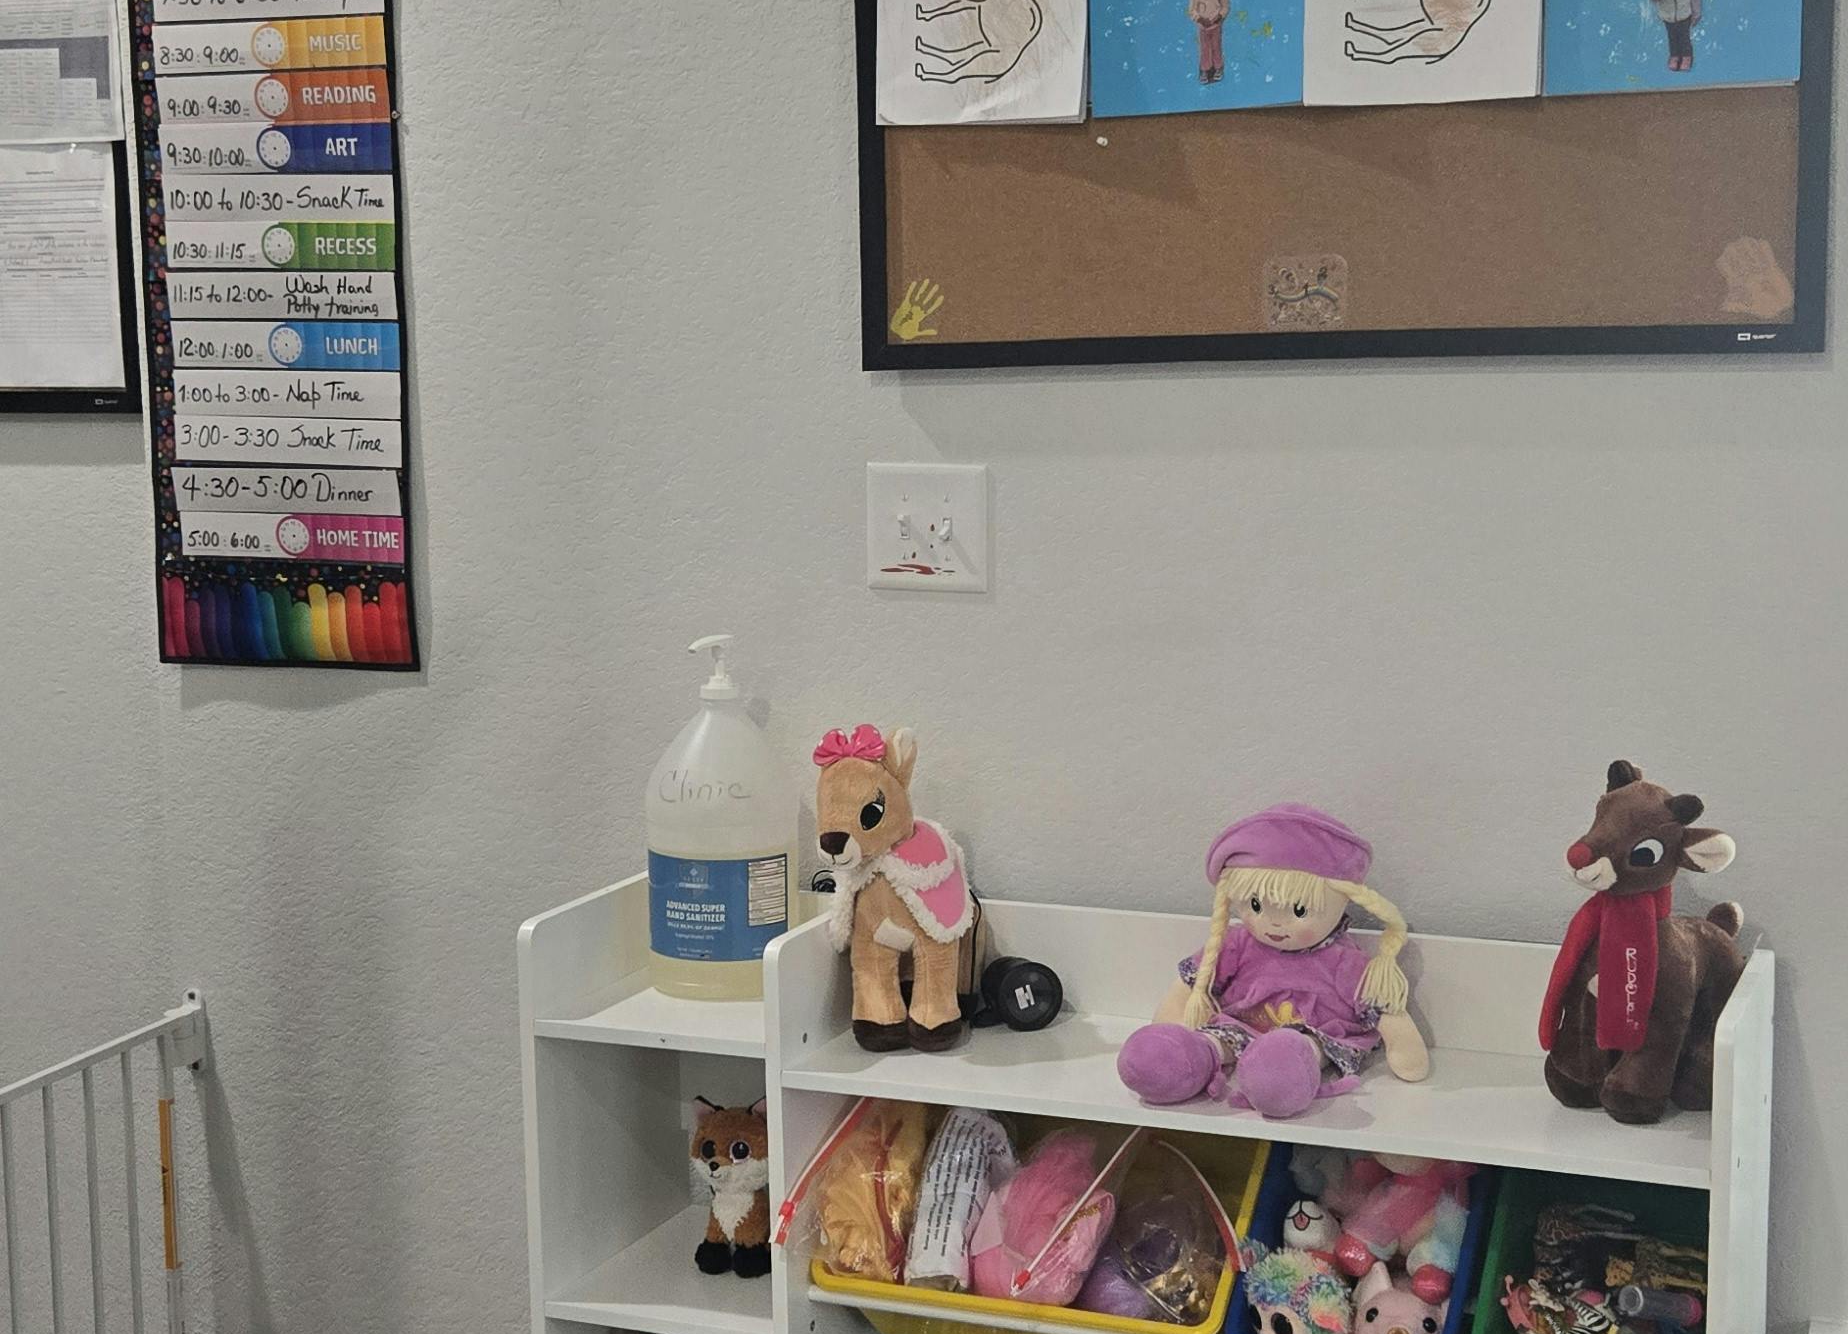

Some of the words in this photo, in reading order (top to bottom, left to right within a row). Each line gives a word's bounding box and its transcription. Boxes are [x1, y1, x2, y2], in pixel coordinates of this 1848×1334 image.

[309, 33, 363, 52] MUSIC
[302, 85, 376, 106] READING
[325, 137, 358, 156] ART
[217, 187, 233, 210] to
[354, 188, 385, 209] Time
[315, 236, 377, 256] RECESS
[206, 282, 222, 303] to
[285, 274, 329, 295] Wash
[337, 275, 373, 295] Hand
[286, 294, 320, 318] Potty
[325, 336, 378, 356] LUNCH
[214, 383, 230, 403] to
[286, 379, 321, 410] Nap
[323, 381, 364, 402] Time
[234, 427, 279, 448] 3:30
[341, 428, 385, 452] Time
[311, 472, 373, 502] Dinner
[316, 528, 359, 547] HOME
[362, 530, 399, 549] TIME
[666, 899, 701, 912] ADVANCED
[701, 903, 726, 913] SUPER
[666, 910, 685, 920] HAND
[686, 912, 726, 922] SANITIZER
